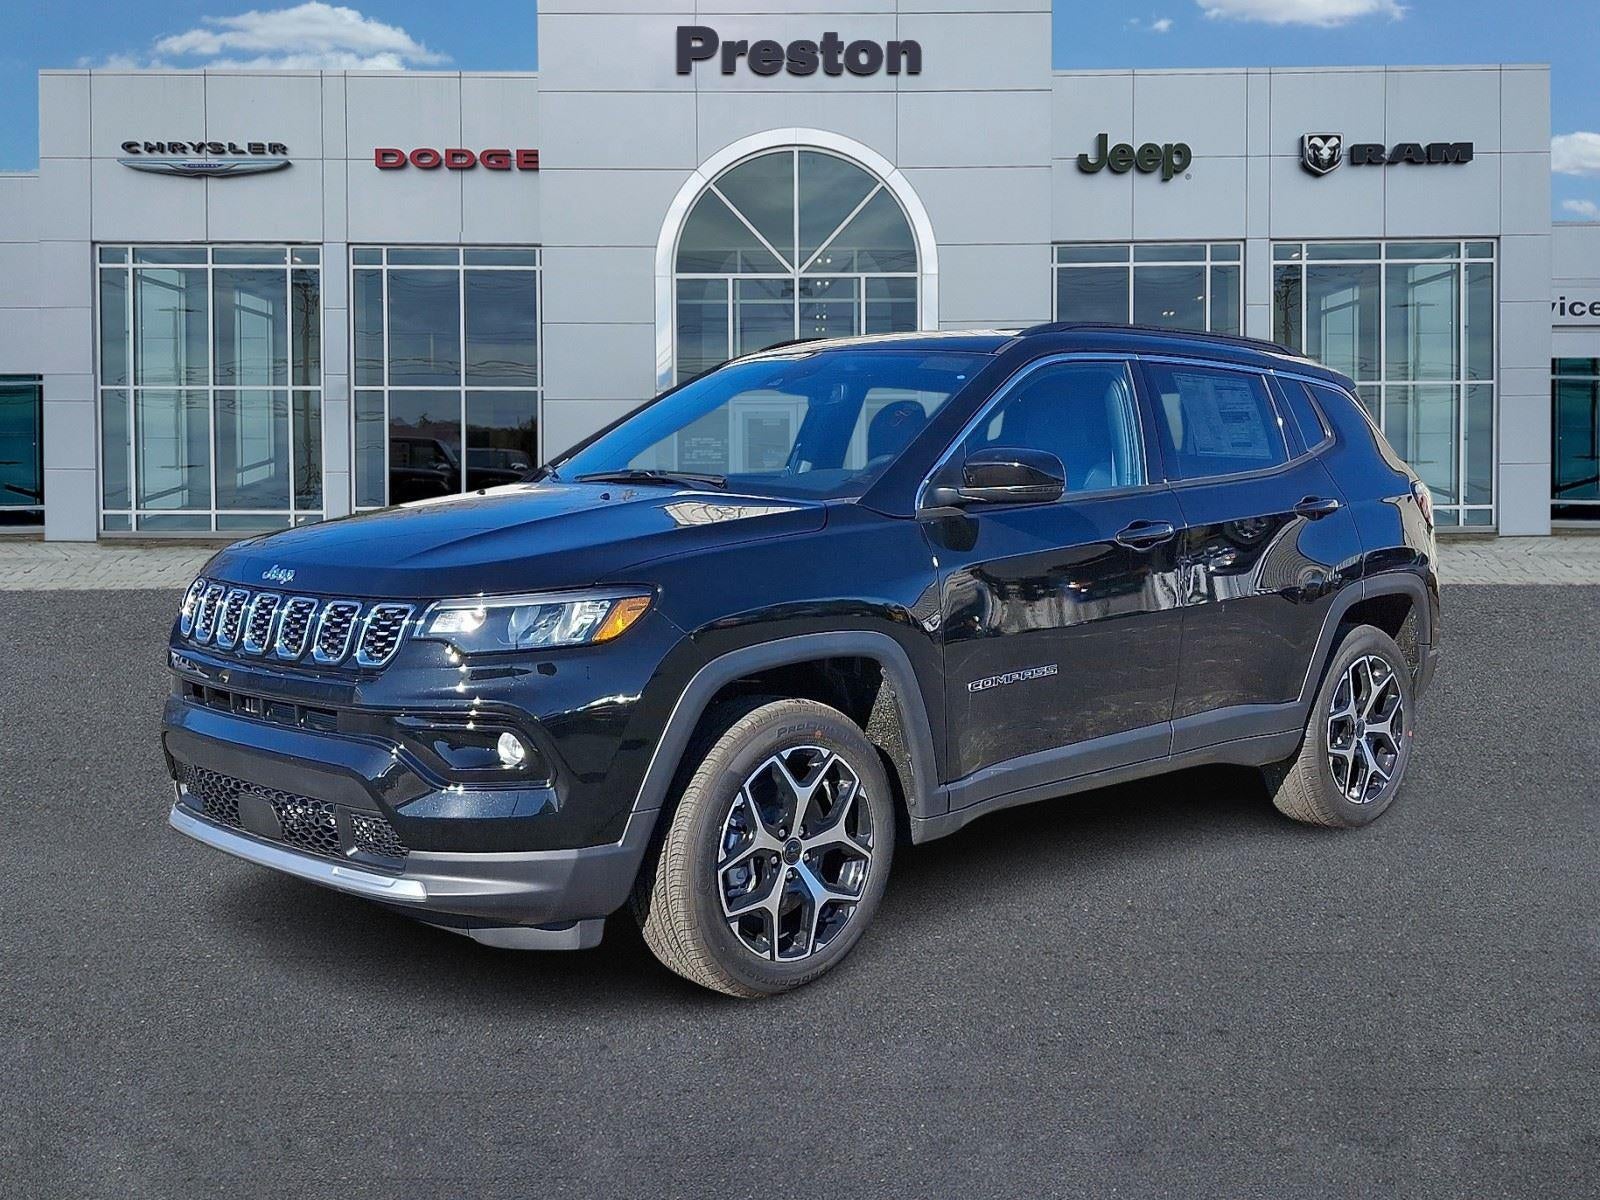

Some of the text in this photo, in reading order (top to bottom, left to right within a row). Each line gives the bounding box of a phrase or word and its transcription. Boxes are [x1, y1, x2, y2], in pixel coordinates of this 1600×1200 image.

[676, 26, 922, 75] Preston
[121, 141, 289, 155] CHRYSLER
[375, 148, 539, 171] DODGE
[1077, 133, 1192, 182] Jeep
[1349, 142, 1474, 165] RAM
[968, 664, 1057, 692] COMPASS
